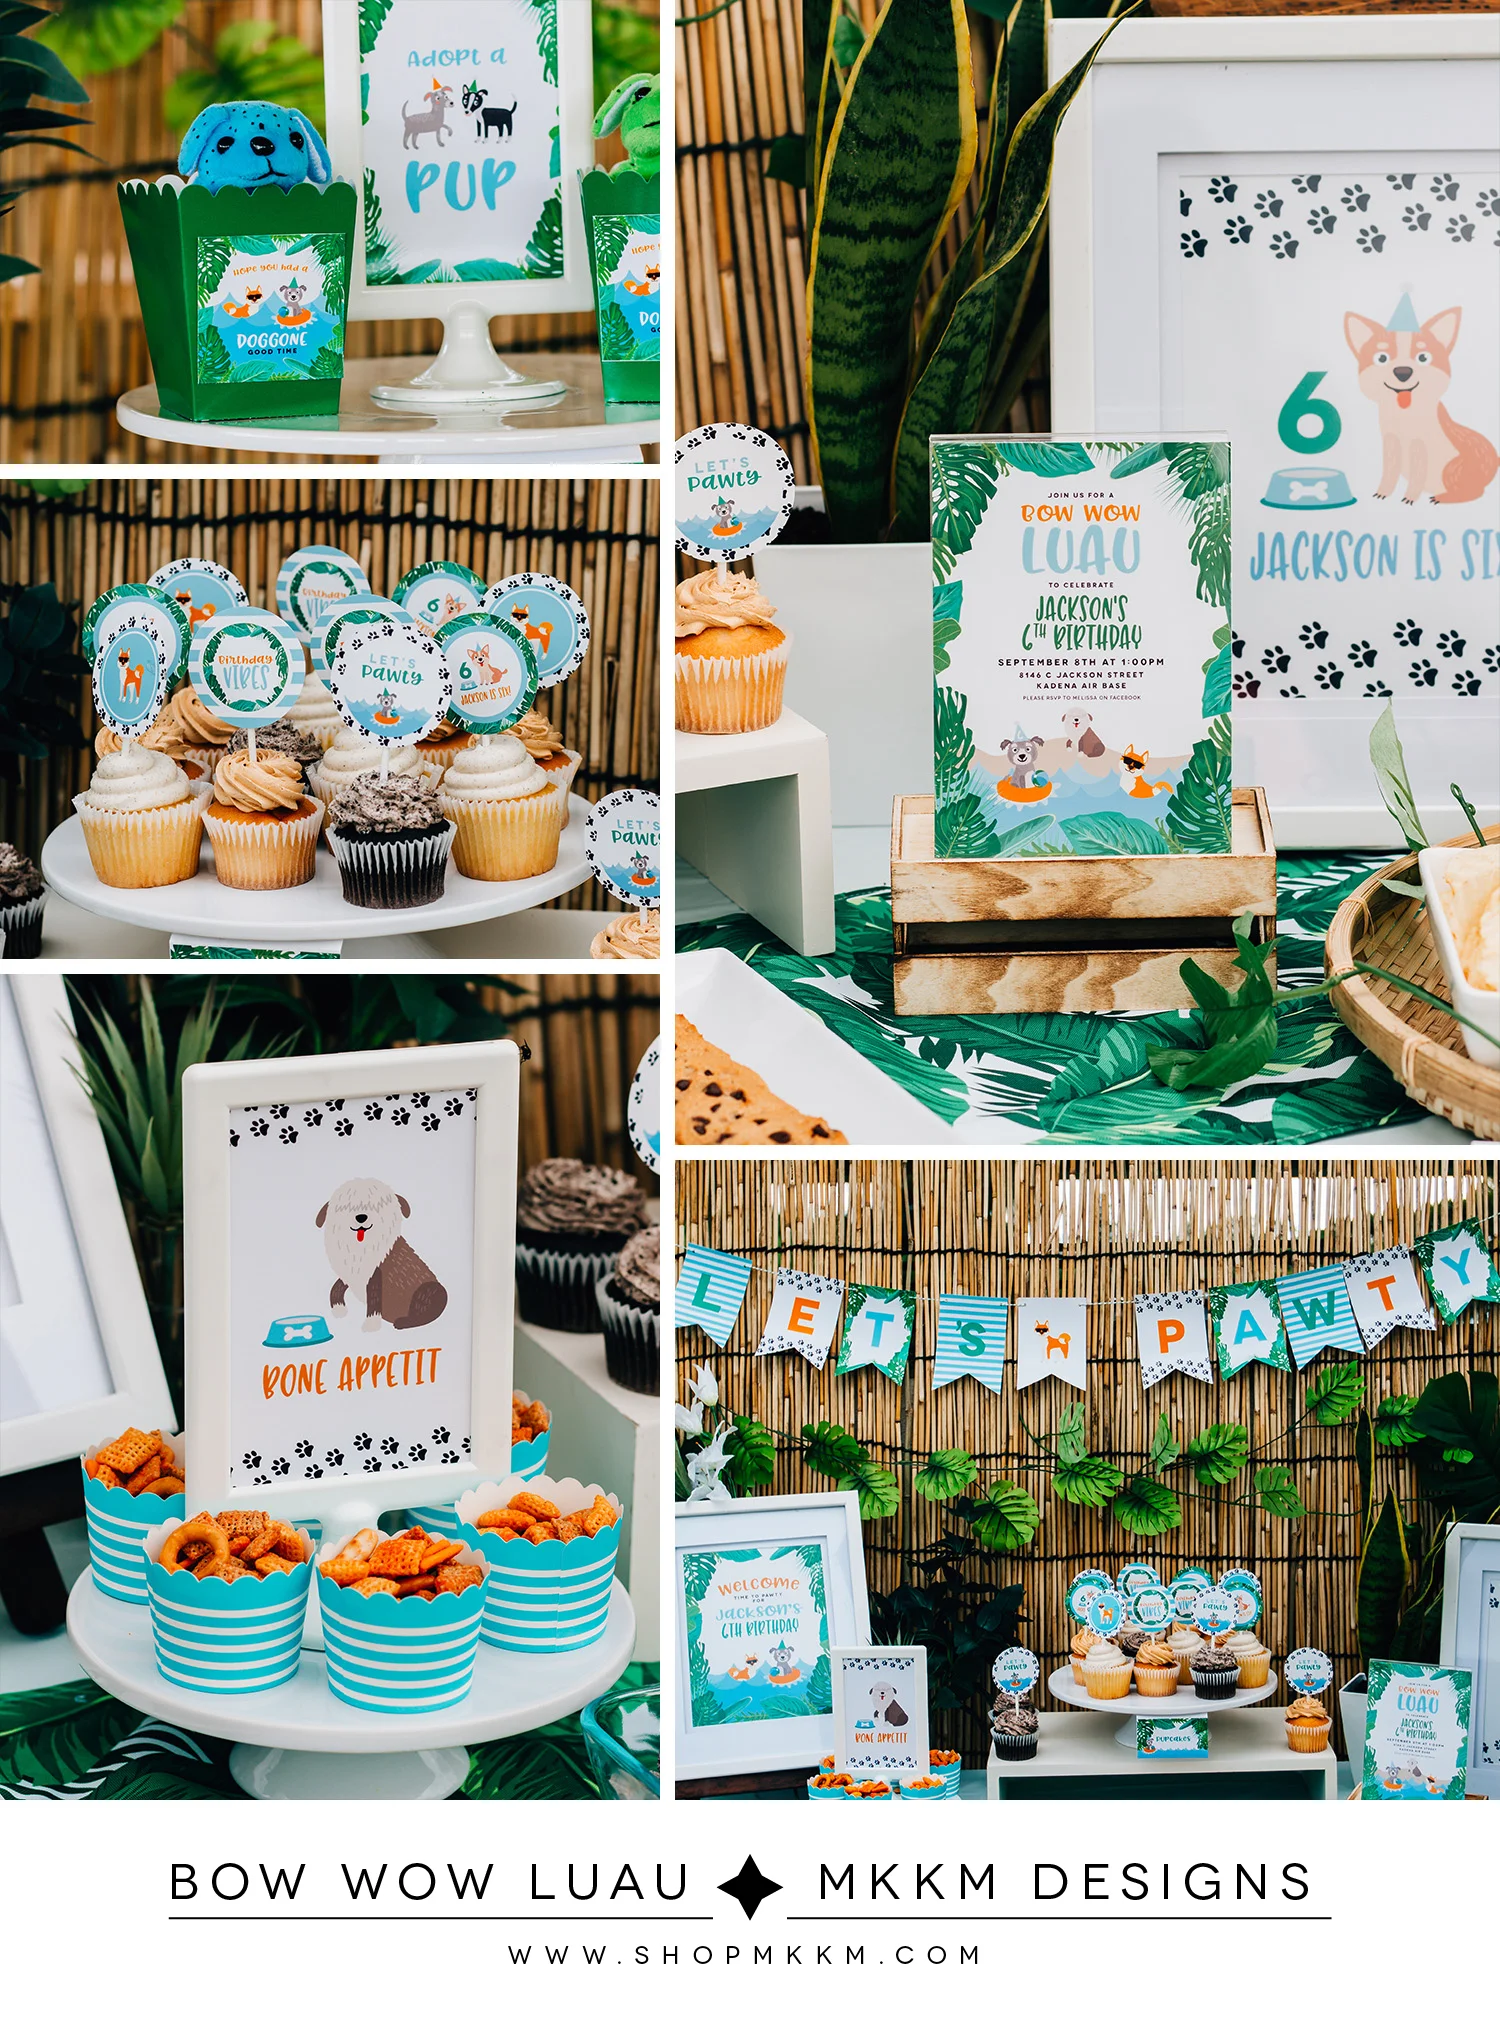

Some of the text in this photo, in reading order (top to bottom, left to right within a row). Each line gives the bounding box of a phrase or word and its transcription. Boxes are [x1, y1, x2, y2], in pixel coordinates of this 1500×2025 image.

[490, 48, 507, 65] a
[405, 157, 517, 214] PUP
[236, 331, 308, 349] DOGGONE
[1277, 371, 1342, 454] 6
[694, 456, 750, 474] LET'S
[1020, 504, 1141, 522] BOW WOW
[1021, 524, 1141, 576] LUAU
[1249, 530, 1398, 582] JACKSON
[1413, 528, 1447, 582] IS
[427, 598, 440, 613] 6
[1035, 594, 1129, 623] JACKSON'S
[1021, 622, 1142, 651] 6TH BIRTHDAY
[218, 655, 273, 665] Birthday
[369, 653, 417, 669] LET'S
[998, 658, 1165, 667] SEPTEMBER 8TH AT 1:00PM
[223, 664, 270, 690] VIBES
[459, 662, 473, 680] 6
[460, 692, 489, 706] JACKSON
[490, 688, 497, 700] IS
[617, 819, 660, 830] LET'S
[611, 830, 660, 847] Pawt
[262, 1348, 442, 1400] BONE APPETIT
[721, 1617, 799, 1639] 6TH BIRTHDAY
[1397, 1693, 1439, 1715] LUAU
[855, 1732, 908, 1743] BONE APPETIT
